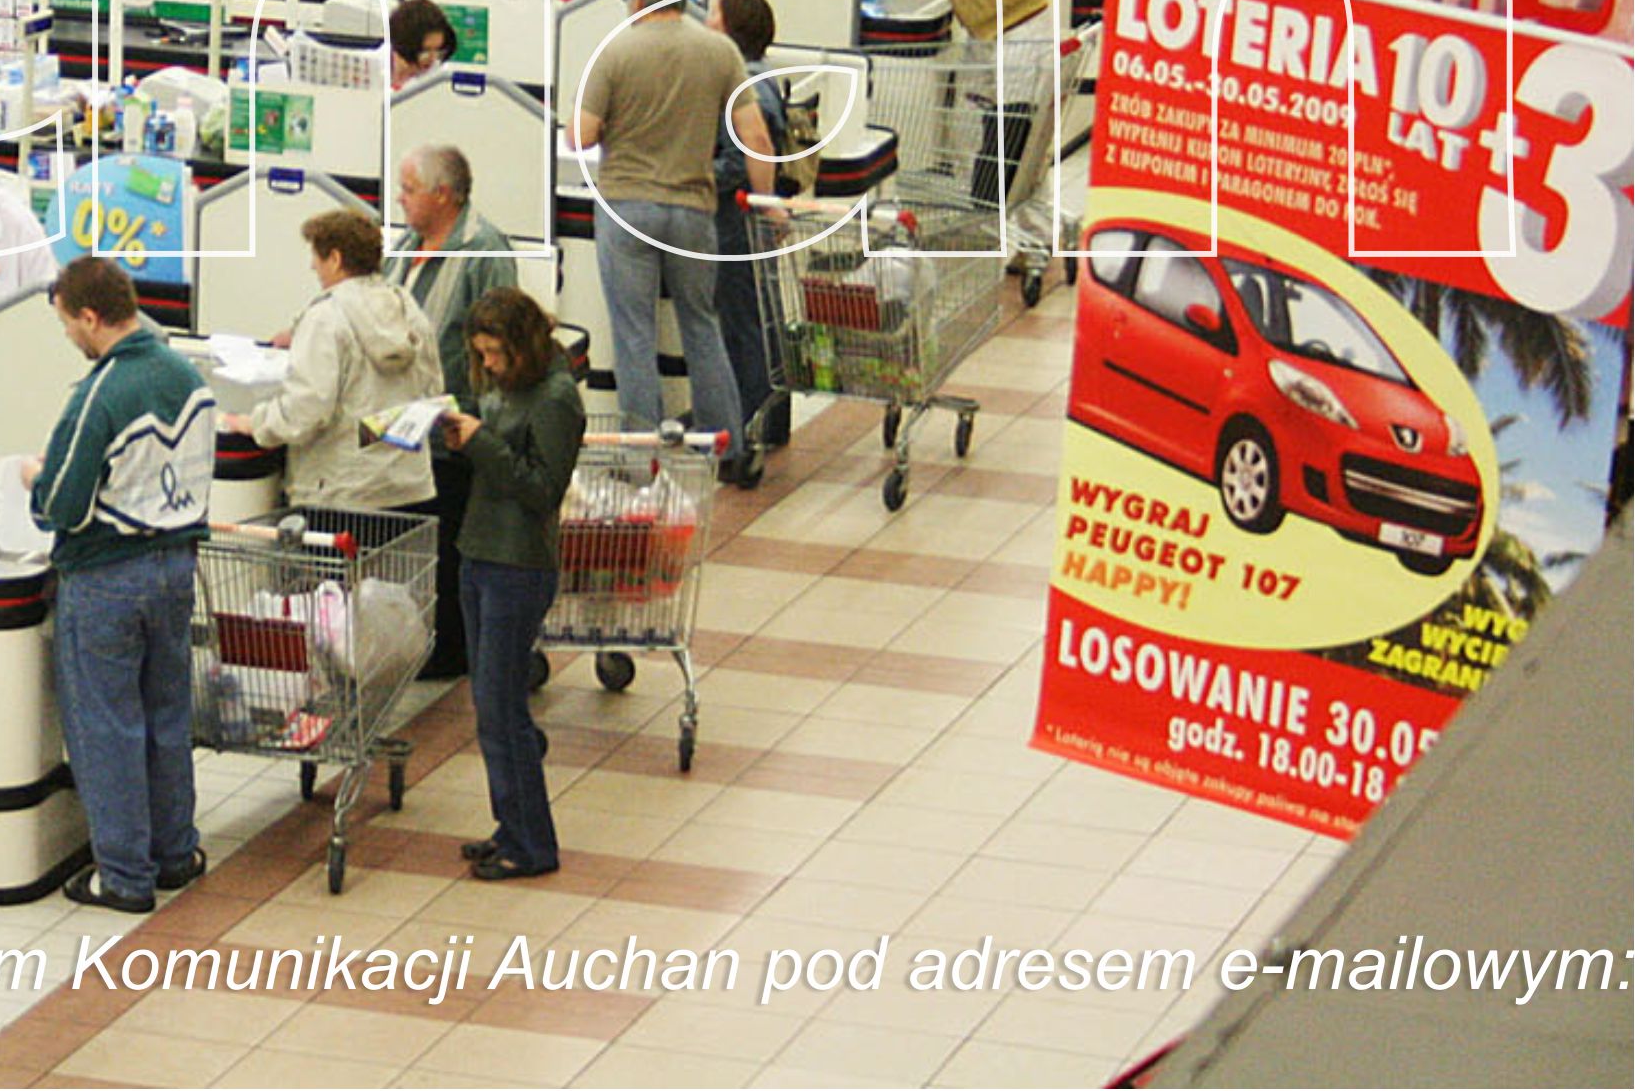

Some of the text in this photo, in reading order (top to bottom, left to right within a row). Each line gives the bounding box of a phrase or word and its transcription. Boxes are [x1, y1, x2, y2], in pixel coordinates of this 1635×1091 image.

[1112, 52, 1357, 129] 06.05.-30.05.2009
[1388, 31, 1488, 132] 10
[1110, 91, 1152, 121] ZRÓB
[1154, 101, 1214, 135] ZAKUPY
[1218, 116, 1241, 140] ZA
[1244, 122, 1322, 163] MINIMUM
[1388, 112, 1469, 171] LAT
[1104, 146, 1116, 165] Z
[1117, 149, 1198, 188] KUPONEM
[1213, 169, 1310, 212] PARAGONEM
[1313, 193, 1338, 218] DO
[1108, 118, 1418, 216] WYPEŁNIJ KUPON LOTERYJNY, ZGŁOŚ SIĘ
[1069, 477, 1212, 540] WYGRAJ
[1060, 550, 1193, 611] HAPPY!
[1063, 514, 1302, 601] PEUGEOT 107
[1056, 618, 1311, 736] LOSOWANIE
[1167, 714, 1245, 763] godz.
[1107, 741, 1131, 763] nie
[1134, 750, 1150, 773] są
[1152, 753, 1200, 789] objęte
[1203, 770, 1254, 806] zakupy
[1255, 786, 1306, 817] paliwa
[1309, 804, 1330, 823] na
